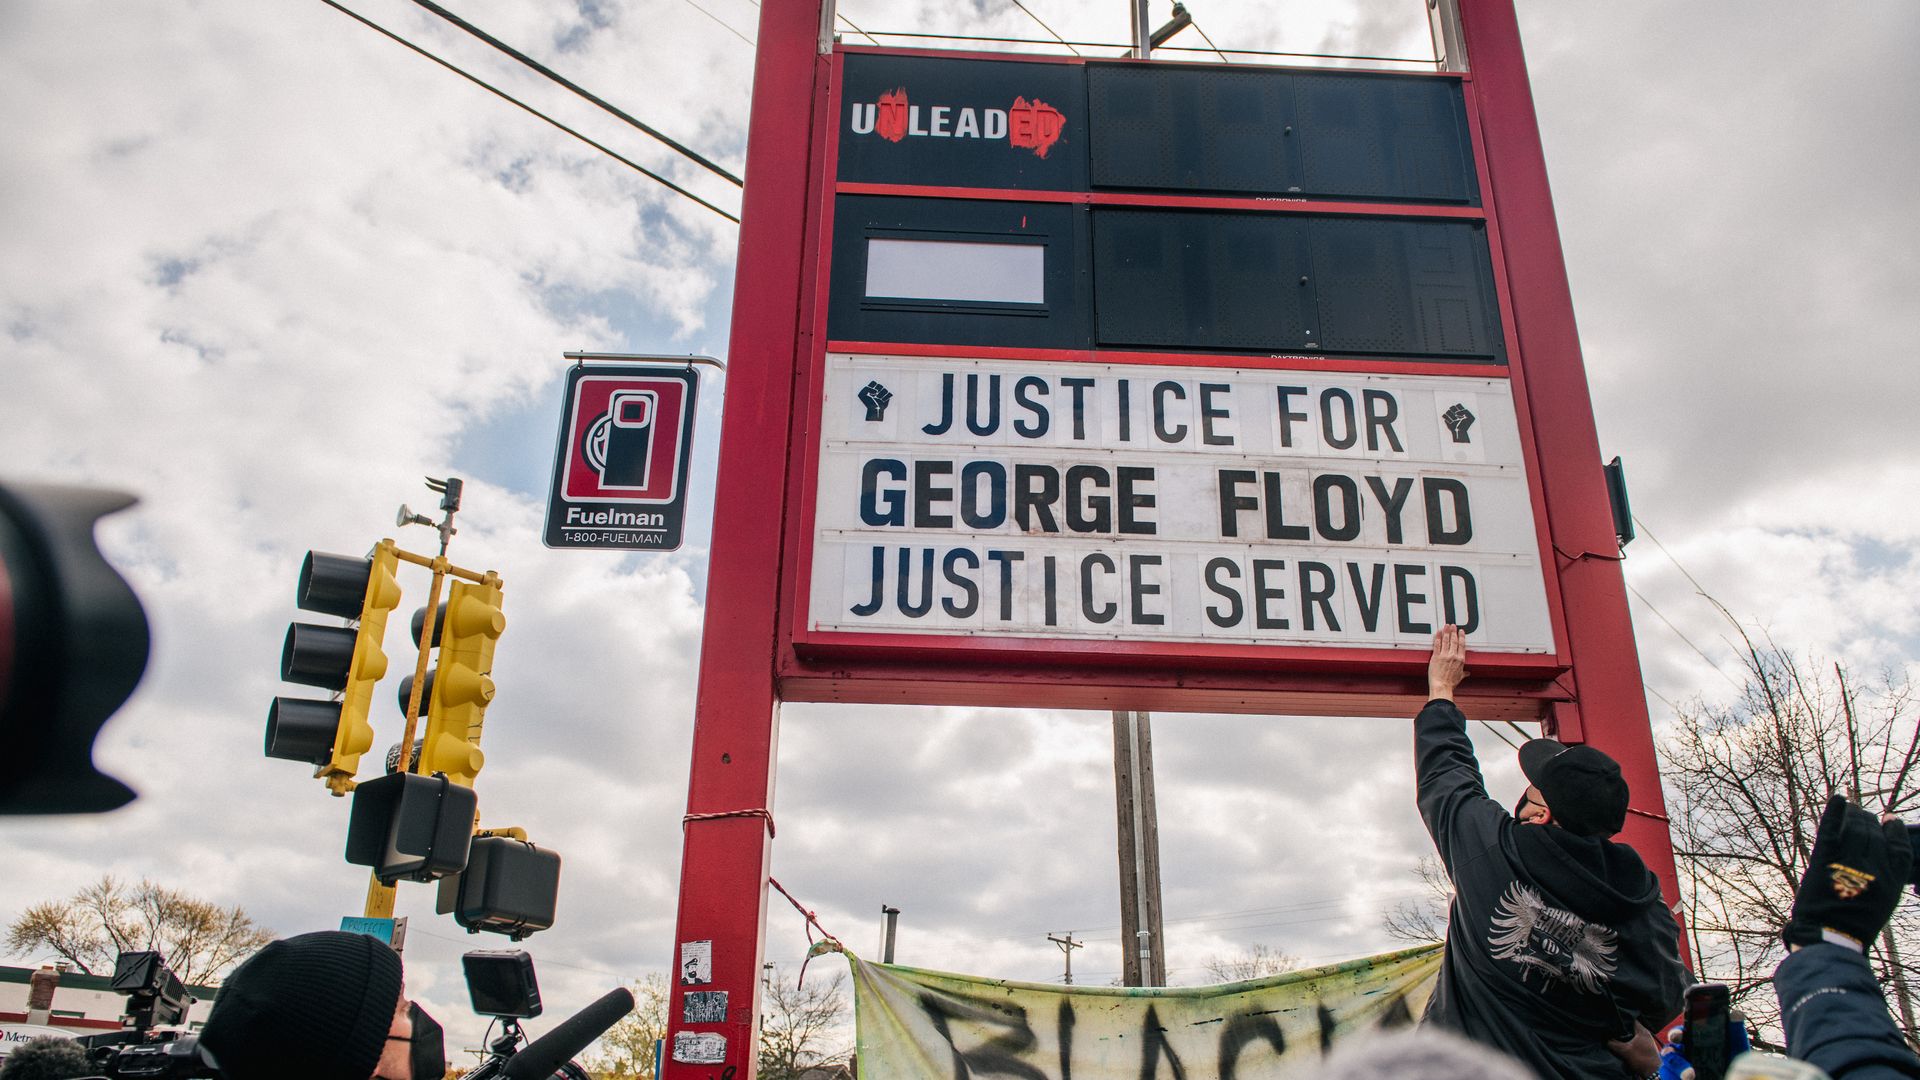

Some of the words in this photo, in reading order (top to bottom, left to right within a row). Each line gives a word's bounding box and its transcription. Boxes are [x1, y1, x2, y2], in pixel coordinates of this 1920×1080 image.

[921, 373, 1234, 446] JUSTICE
[1276, 385, 1404, 453] FOR
[564, 532, 663, 545] 1-800-FUELMAN
[566, 507, 664, 527] Fuelman
[859, 458, 1157, 535] GEORGE
[1218, 469, 1473, 546] FLOYD
[849, 546, 1165, 627] JUSTICE
[1204, 556, 1480, 635] SERVED
